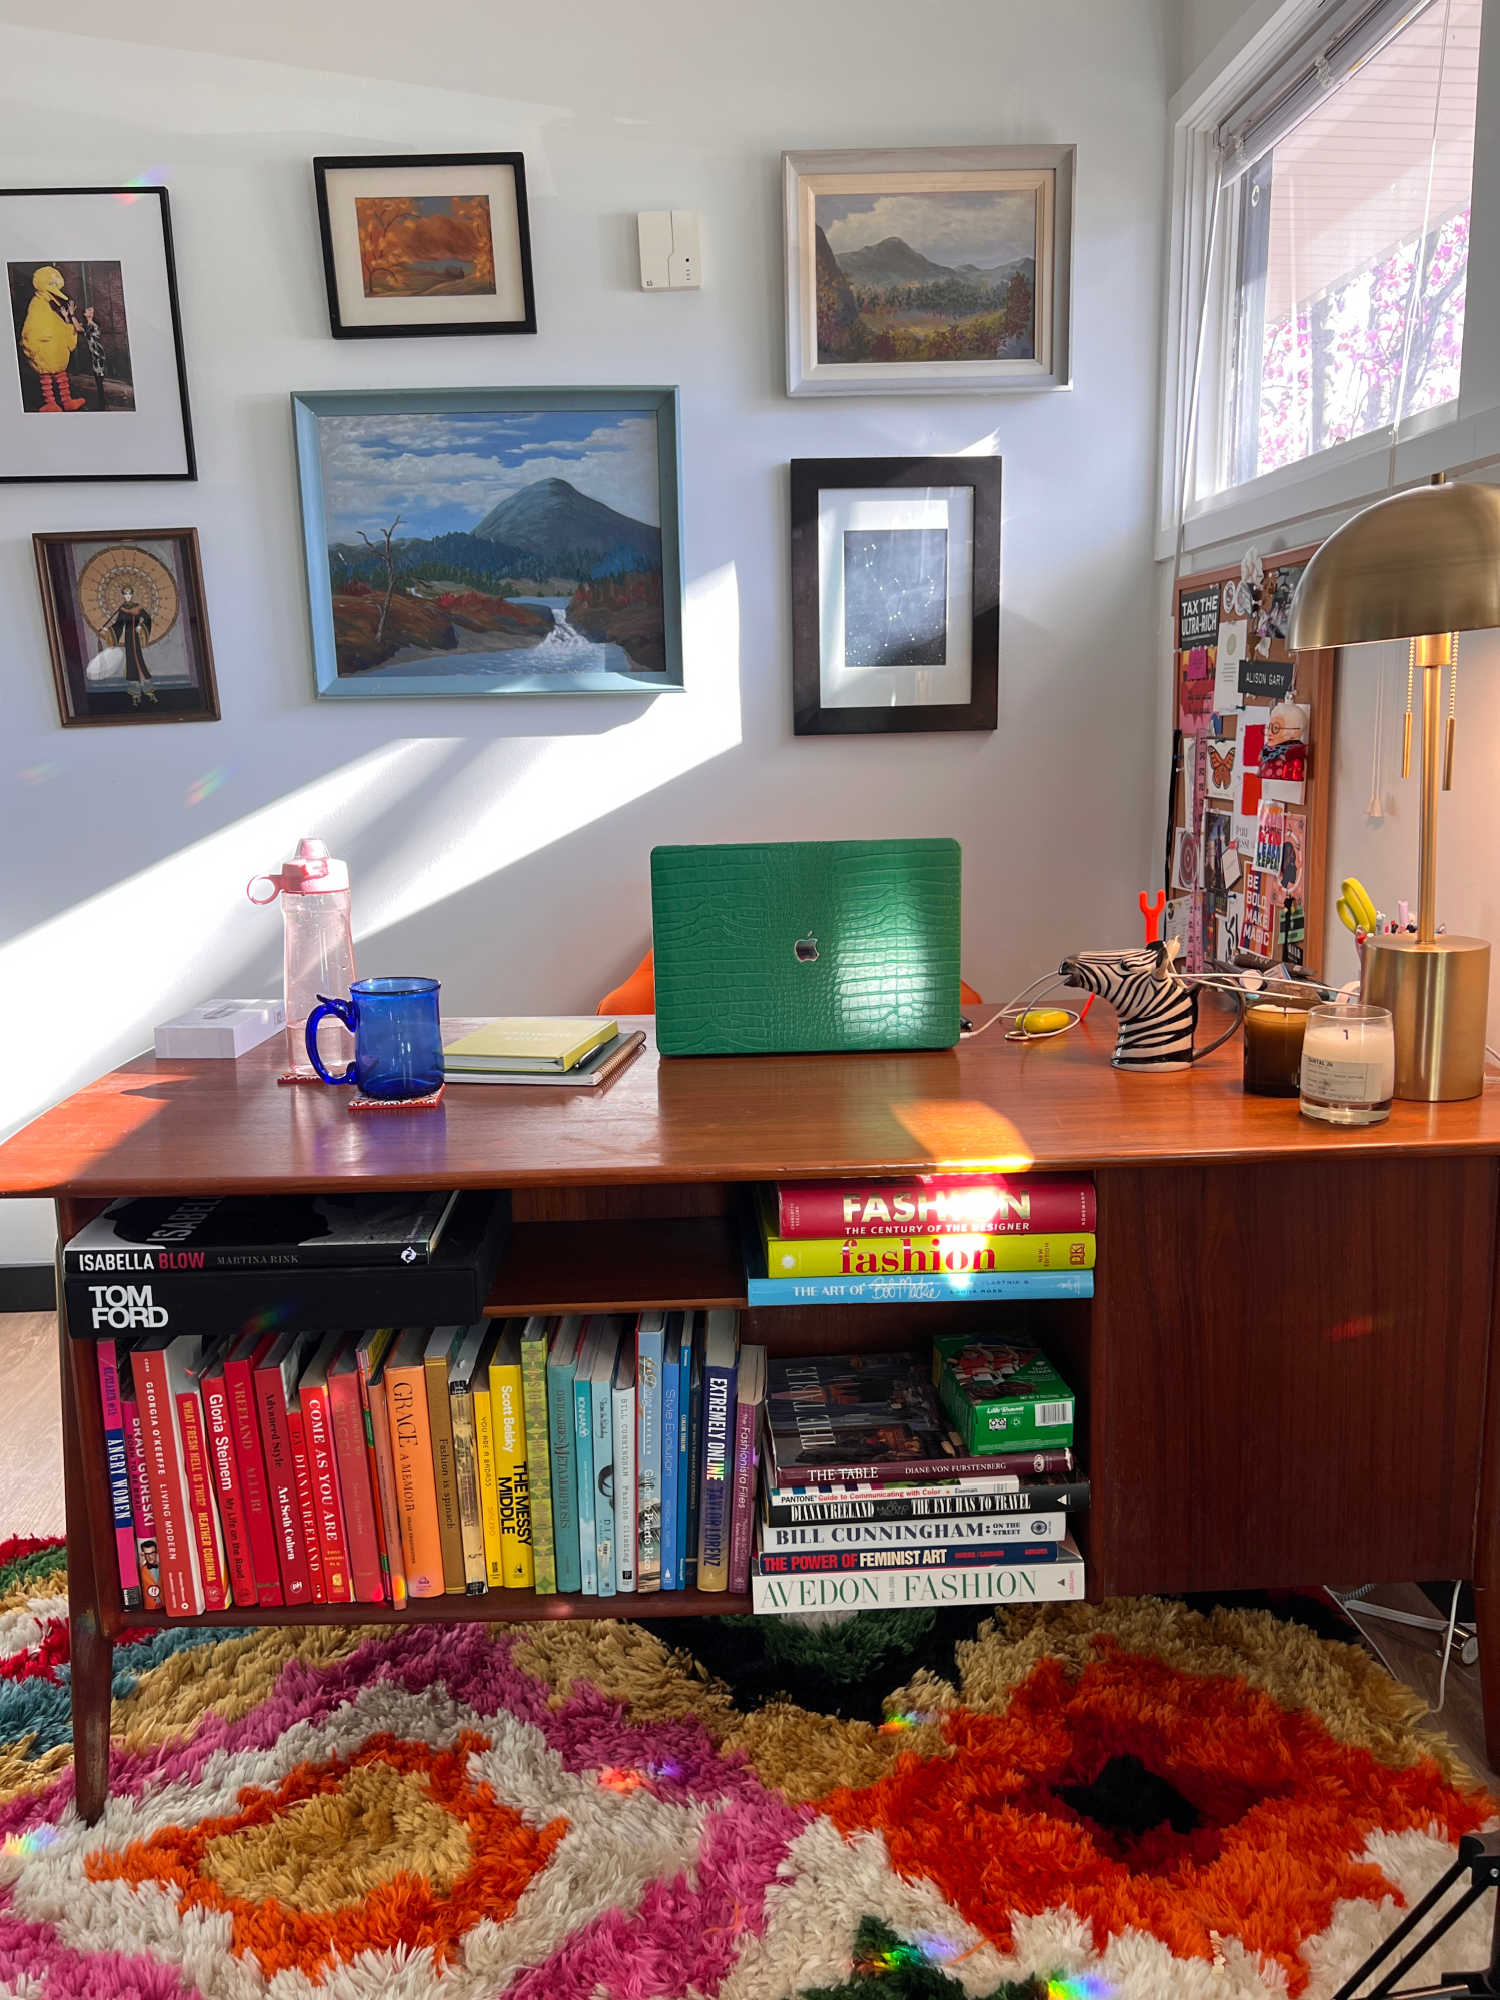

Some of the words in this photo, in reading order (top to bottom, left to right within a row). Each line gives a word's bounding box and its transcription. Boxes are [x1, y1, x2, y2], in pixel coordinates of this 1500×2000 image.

[1181, 601, 1199, 614] TAX
[1200, 595, 1218, 611] THE
[1181, 613, 1217, 635] ULTRA-RICH
[1245, 672, 1267, 685] ALISON
[1268, 673, 1285, 686] GARY
[1247, 874, 1259, 889] BE
[1247, 890, 1267, 909] BOLD
[1246, 908, 1269, 930] MAKE
[1244, 924, 1270, 946] MAGIC
[845, 1226, 867, 1235] THE
[870, 1224, 924, 1235] CENTURY
[927, 1223, 943, 1233] OF
[945, 1222, 969, 1232] THE
[971, 1222, 1031, 1233] DESIGNER
[79, 1251, 154, 1271] ISABELLA
[158, 1251, 205, 1269] BLOW
[216, 1256, 266, 1266] MARTINA
[271, 1254, 299, 1265] RINK
[839, 1238, 997, 1275] fashion
[1070, 1243, 1085, 1265] DK
[88, 1285, 153, 1308] TOM
[793, 1286, 817, 1297] THE
[821, 1285, 848, 1296] ART
[850, 1283, 866, 1296] OF
[92, 1306, 169, 1329] FORD
[146, 1382, 158, 1426] GEORGIA
[183, 1400, 194, 1424] WHAT
[209, 1394, 224, 1433] Gloria
[232, 1381, 253, 1450] VREELAND
[265, 1392, 279, 1440] Advanced
[392, 1382, 418, 1448] GRACE
[501, 1385, 513, 1416] Scott
[620, 1398, 629, 1420] BILL
[664, 1389, 676, 1421] Style
[706, 1378, 728, 1439] EXTREMELY
[309, 1399, 325, 1444] COME
[480, 1416, 488, 1434] YOU
[503, 1417, 516, 1453] Belsky
[132, 1418, 145, 1457] BRAD
[152, 1429, 165, 1476] O'KEEFFE
[186, 1425, 198, 1451] FRESH
[482, 1435, 490, 1449] ARE
[621, 1424, 630, 1477] CUNNINGHAM
[663, 1423, 676, 1476] Evolution
[107, 1438, 126, 1478] ANGRY
[190, 1452, 200, 1472] HELL
[215, 1435, 232, 1491] Steinem
[271, 1441, 284, 1468] Style
[315, 1448, 328, 1469] AS
[400, 1454, 409, 1462] A
[438, 1438, 450, 1476] Fashion
[705, 1442, 726, 1481] ONLINE
[738, 1426, 751, 1484] Fashionista
[192, 1473, 202, 1482] IS
[294, 1454, 309, 1497] DIANA
[442, 1479, 452, 1488] is
[483, 1459, 492, 1488] BADASS
[513, 1461, 527, 1494] THE
[643, 1469, 654, 1500] Guide
[808, 1469, 836, 1482] THE
[839, 1467, 879, 1480] TABLE
[905, 1466, 930, 1474] DIANE
[931, 1465, 950, 1473] VON
[951, 1462, 1007, 1472] FURSTENBERG
[113, 1480, 131, 1521] WOMEN
[138, 1462, 155, 1527] GORESKI
[160, 1483, 171, 1518] LIVING
[194, 1483, 205, 1507] THIS?
[319, 1472, 333, 1506] YOU
[399, 1464, 415, 1512] MEMOIR
[621, 1485, 630, 1520] Fashion
[737, 1485, 749, 1509] Files
[781, 1496, 816, 1504] PANTONE
[818, 1493, 838, 1501] Guide
[840, 1493, 848, 1501] to
[850, 1490, 904, 1502] Communicating
[905, 1489, 921, 1498] with
[922, 1488, 941, 1497] Color
[224, 1498, 235, 1511] My
[280, 1505, 292, 1527] Seth
[442, 1492, 455, 1530] spinach
[498, 1476, 516, 1535] MIDDLE
[705, 1487, 724, 1527] TAYLOR
[791, 1505, 822, 1522] DIANA
[823, 1501, 875, 1520] VREELAND
[911, 1499, 931, 1515] THE
[933, 1497, 953, 1513] EYE
[955, 1496, 976, 1512] HAS
[978, 1496, 992, 1511] TO
[994, 1494, 1031, 1511] TRAVEL
[197, 1512, 211, 1546] HEATHER
[226, 1513, 238, 1529] Life
[231, 1531, 239, 1541] on
[323, 1510, 338, 1542] ARE
[515, 1495, 532, 1546] MESSY
[643, 1512, 653, 1545] Puerto
[775, 1528, 820, 1546] BILL
[831, 1521, 991, 1545] CUNNINGHAM:
[165, 1520, 176, 1560] MODERN
[232, 1543, 241, 1556] the
[283, 1528, 296, 1560] Cohen
[300, 1501, 321, 1572] VREELAND
[621, 1525, 631, 1563] Climbing
[703, 1528, 723, 1567] LORENZ
[203, 1547, 217, 1582] CORINNA
[234, 1557, 244, 1579] Road
[643, 1547, 654, 1570] Rico
[763, 1556, 788, 1572] THE
[790, 1554, 839, 1571] POWER
[841, 1552, 858, 1568] OF
[859, 1550, 920, 1568] FEMINIST
[922, 1548, 948, 1564] ART
[760, 1576, 881, 1609] AVEDON
[904, 1570, 1038, 1602] FASHION
